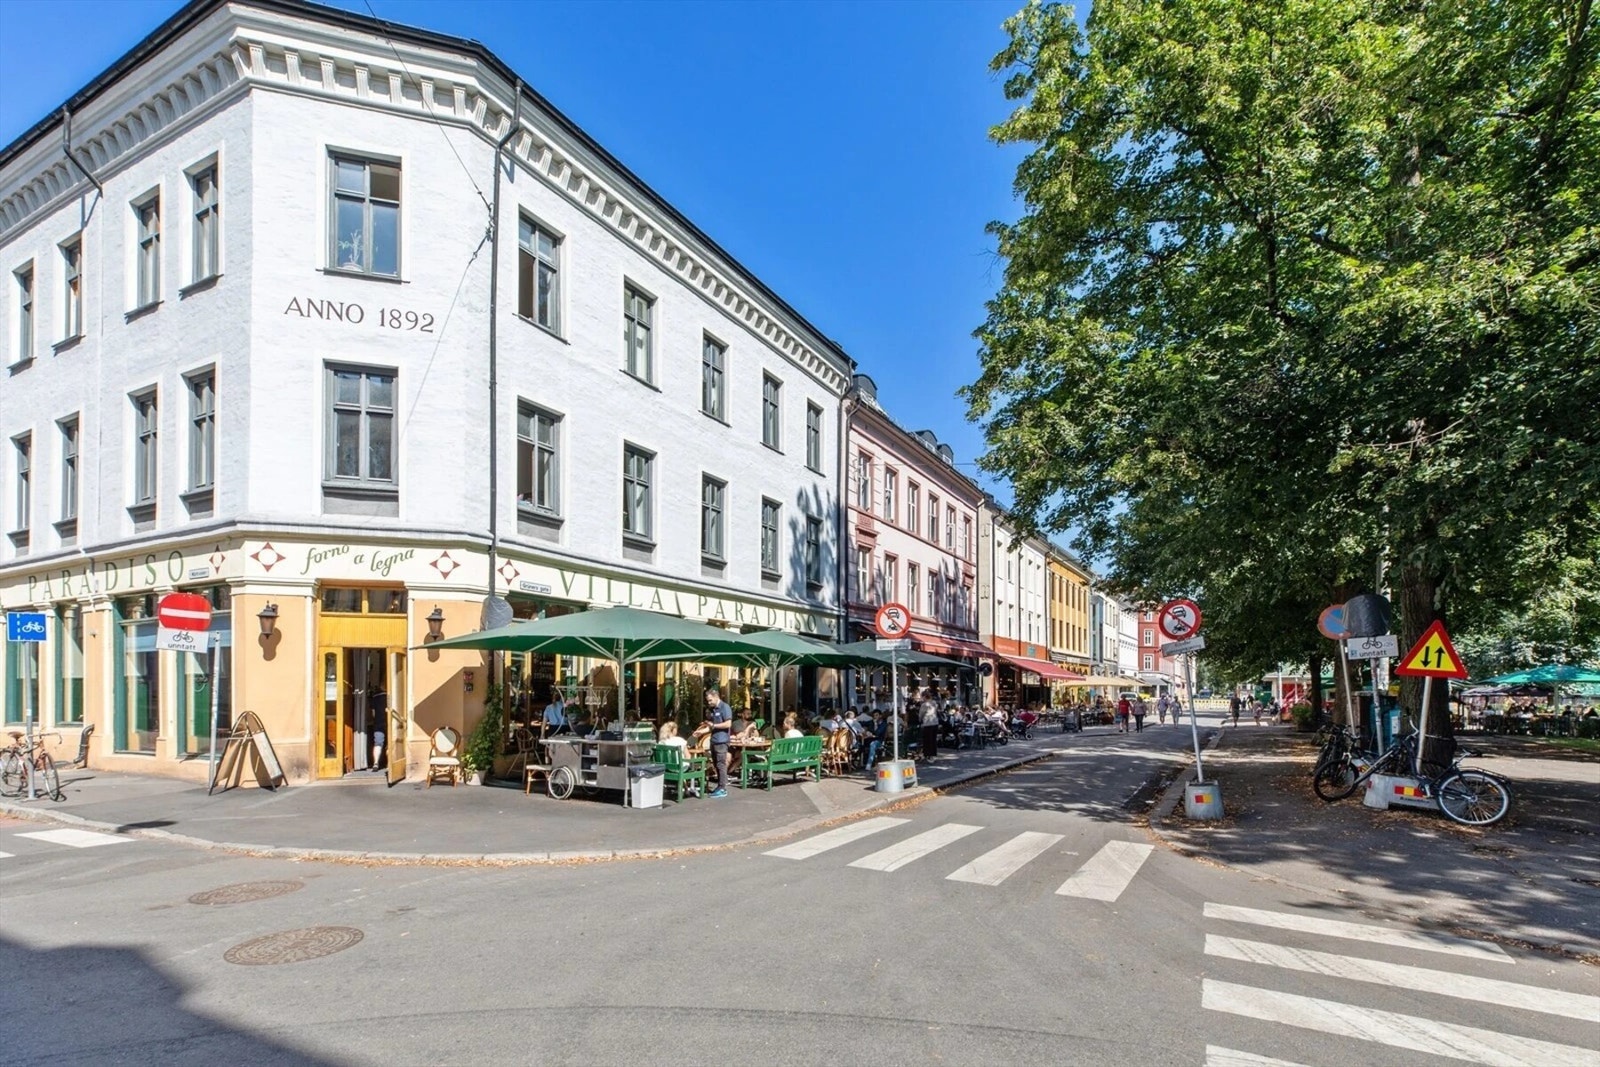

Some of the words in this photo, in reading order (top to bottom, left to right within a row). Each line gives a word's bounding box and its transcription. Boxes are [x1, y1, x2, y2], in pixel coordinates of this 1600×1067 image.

[284, 296, 364, 324] ANNO
[379, 307, 435, 333] 1892
[28, 550, 184, 602] PARADISO
[300, 544, 350, 575] forno
[353, 552, 365, 565] a
[370, 548, 415, 577] legna
[558, 569, 664, 611] VILLA
[697, 594, 817, 632] PARADISO
[1359, 649, 1388, 657] unntatt
